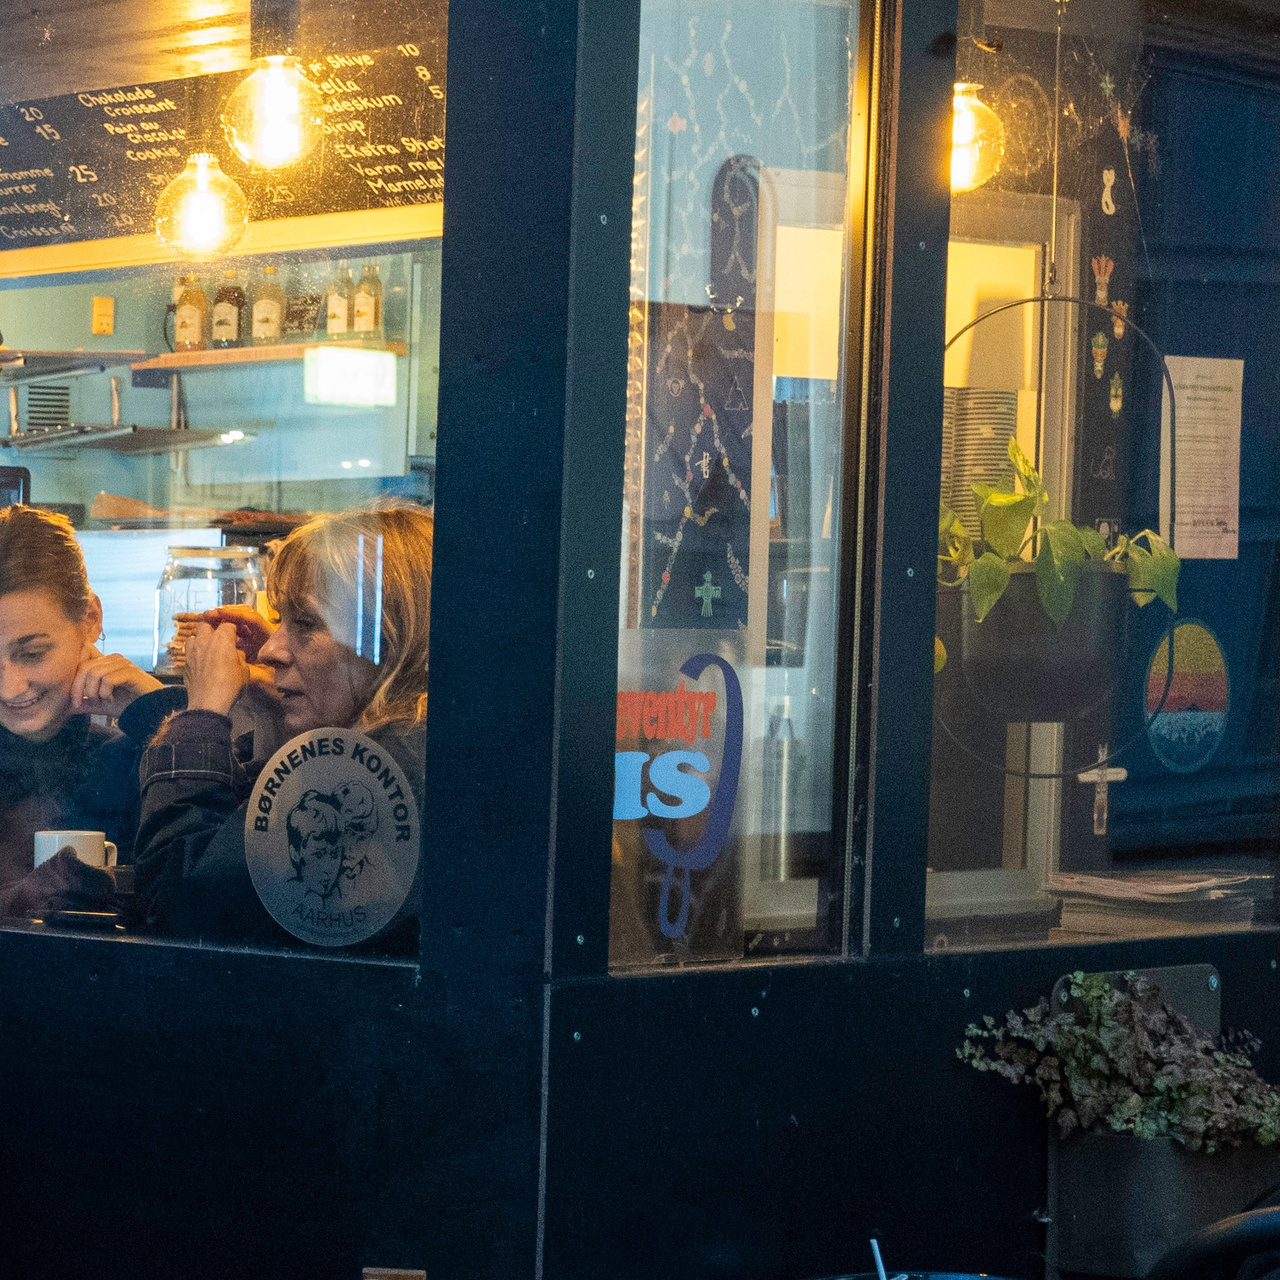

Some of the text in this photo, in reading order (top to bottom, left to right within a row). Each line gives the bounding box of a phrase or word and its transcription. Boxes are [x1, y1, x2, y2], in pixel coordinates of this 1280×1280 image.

[326, 54, 375, 69] Skive
[397, 43, 420, 57] 10
[314, 65, 431, 95] tella 8
[77, 86, 157, 108] Chokolade
[428, 85, 444, 99] 5
[20, 107, 44, 122] 20
[103, 97, 178, 118] Croissant
[35, 123, 61, 141] 15
[103, 120, 160, 136] Pain au
[70, 164, 98, 183] 25
[348, 162, 404, 177] Varm
[366, 174, 445, 195] Marmelad
[254, 738, 411, 842] BØRNENES KONTOR
[291, 902, 367, 927] AARHUS
